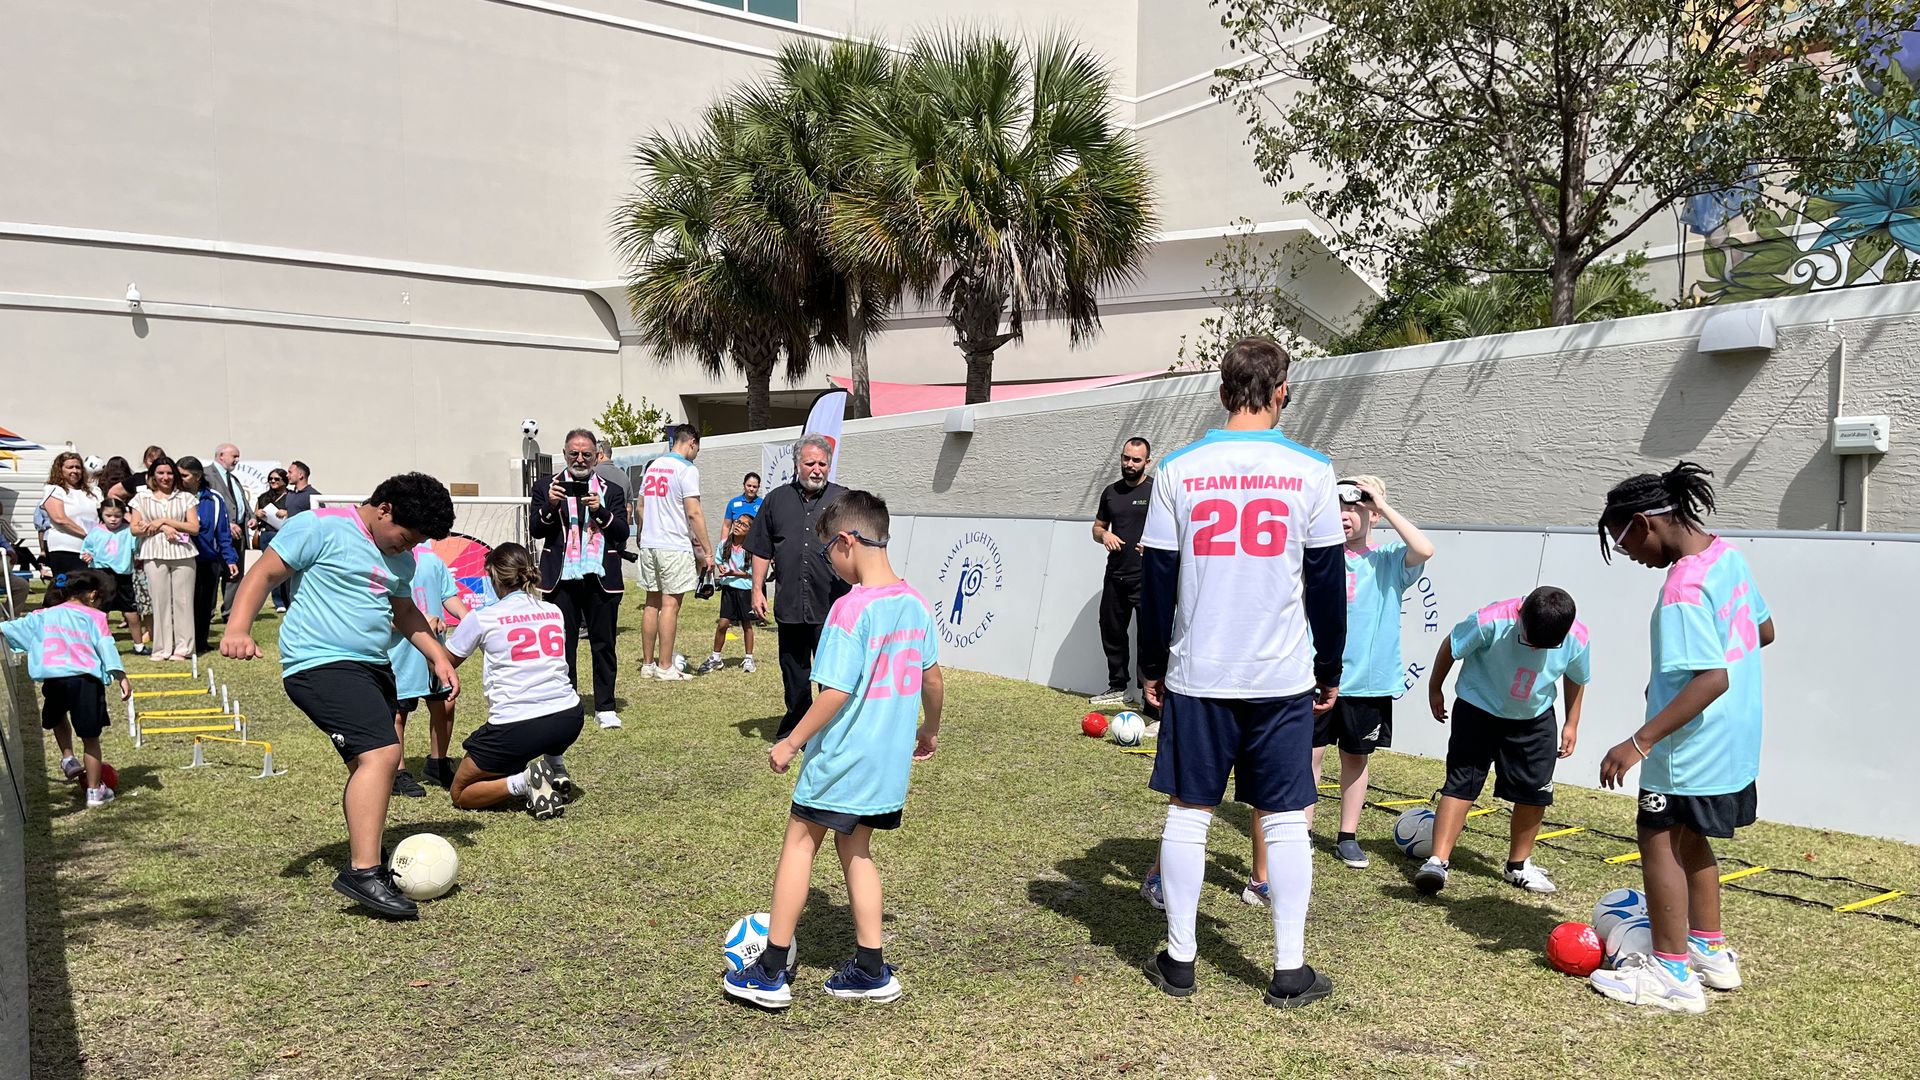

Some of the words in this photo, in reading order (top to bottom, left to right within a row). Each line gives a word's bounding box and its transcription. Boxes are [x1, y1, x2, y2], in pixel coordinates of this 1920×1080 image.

[644, 475, 669, 497] 26
[1183, 476, 1238, 492] TEAM
[1240, 475, 1302, 491] MIAMI
[1191, 498, 1289, 557] 26
[938, 540, 962, 582] MIAMI
[965, 531, 1002, 591] LIGHTHOUSE
[497, 613, 531, 625] TEAM
[934, 600, 953, 643] BLIND
[954, 611, 994, 648] SOCCER
[43, 637, 96, 669] 26
[507, 624, 564, 661] 26
[866, 647, 922, 699] 26
